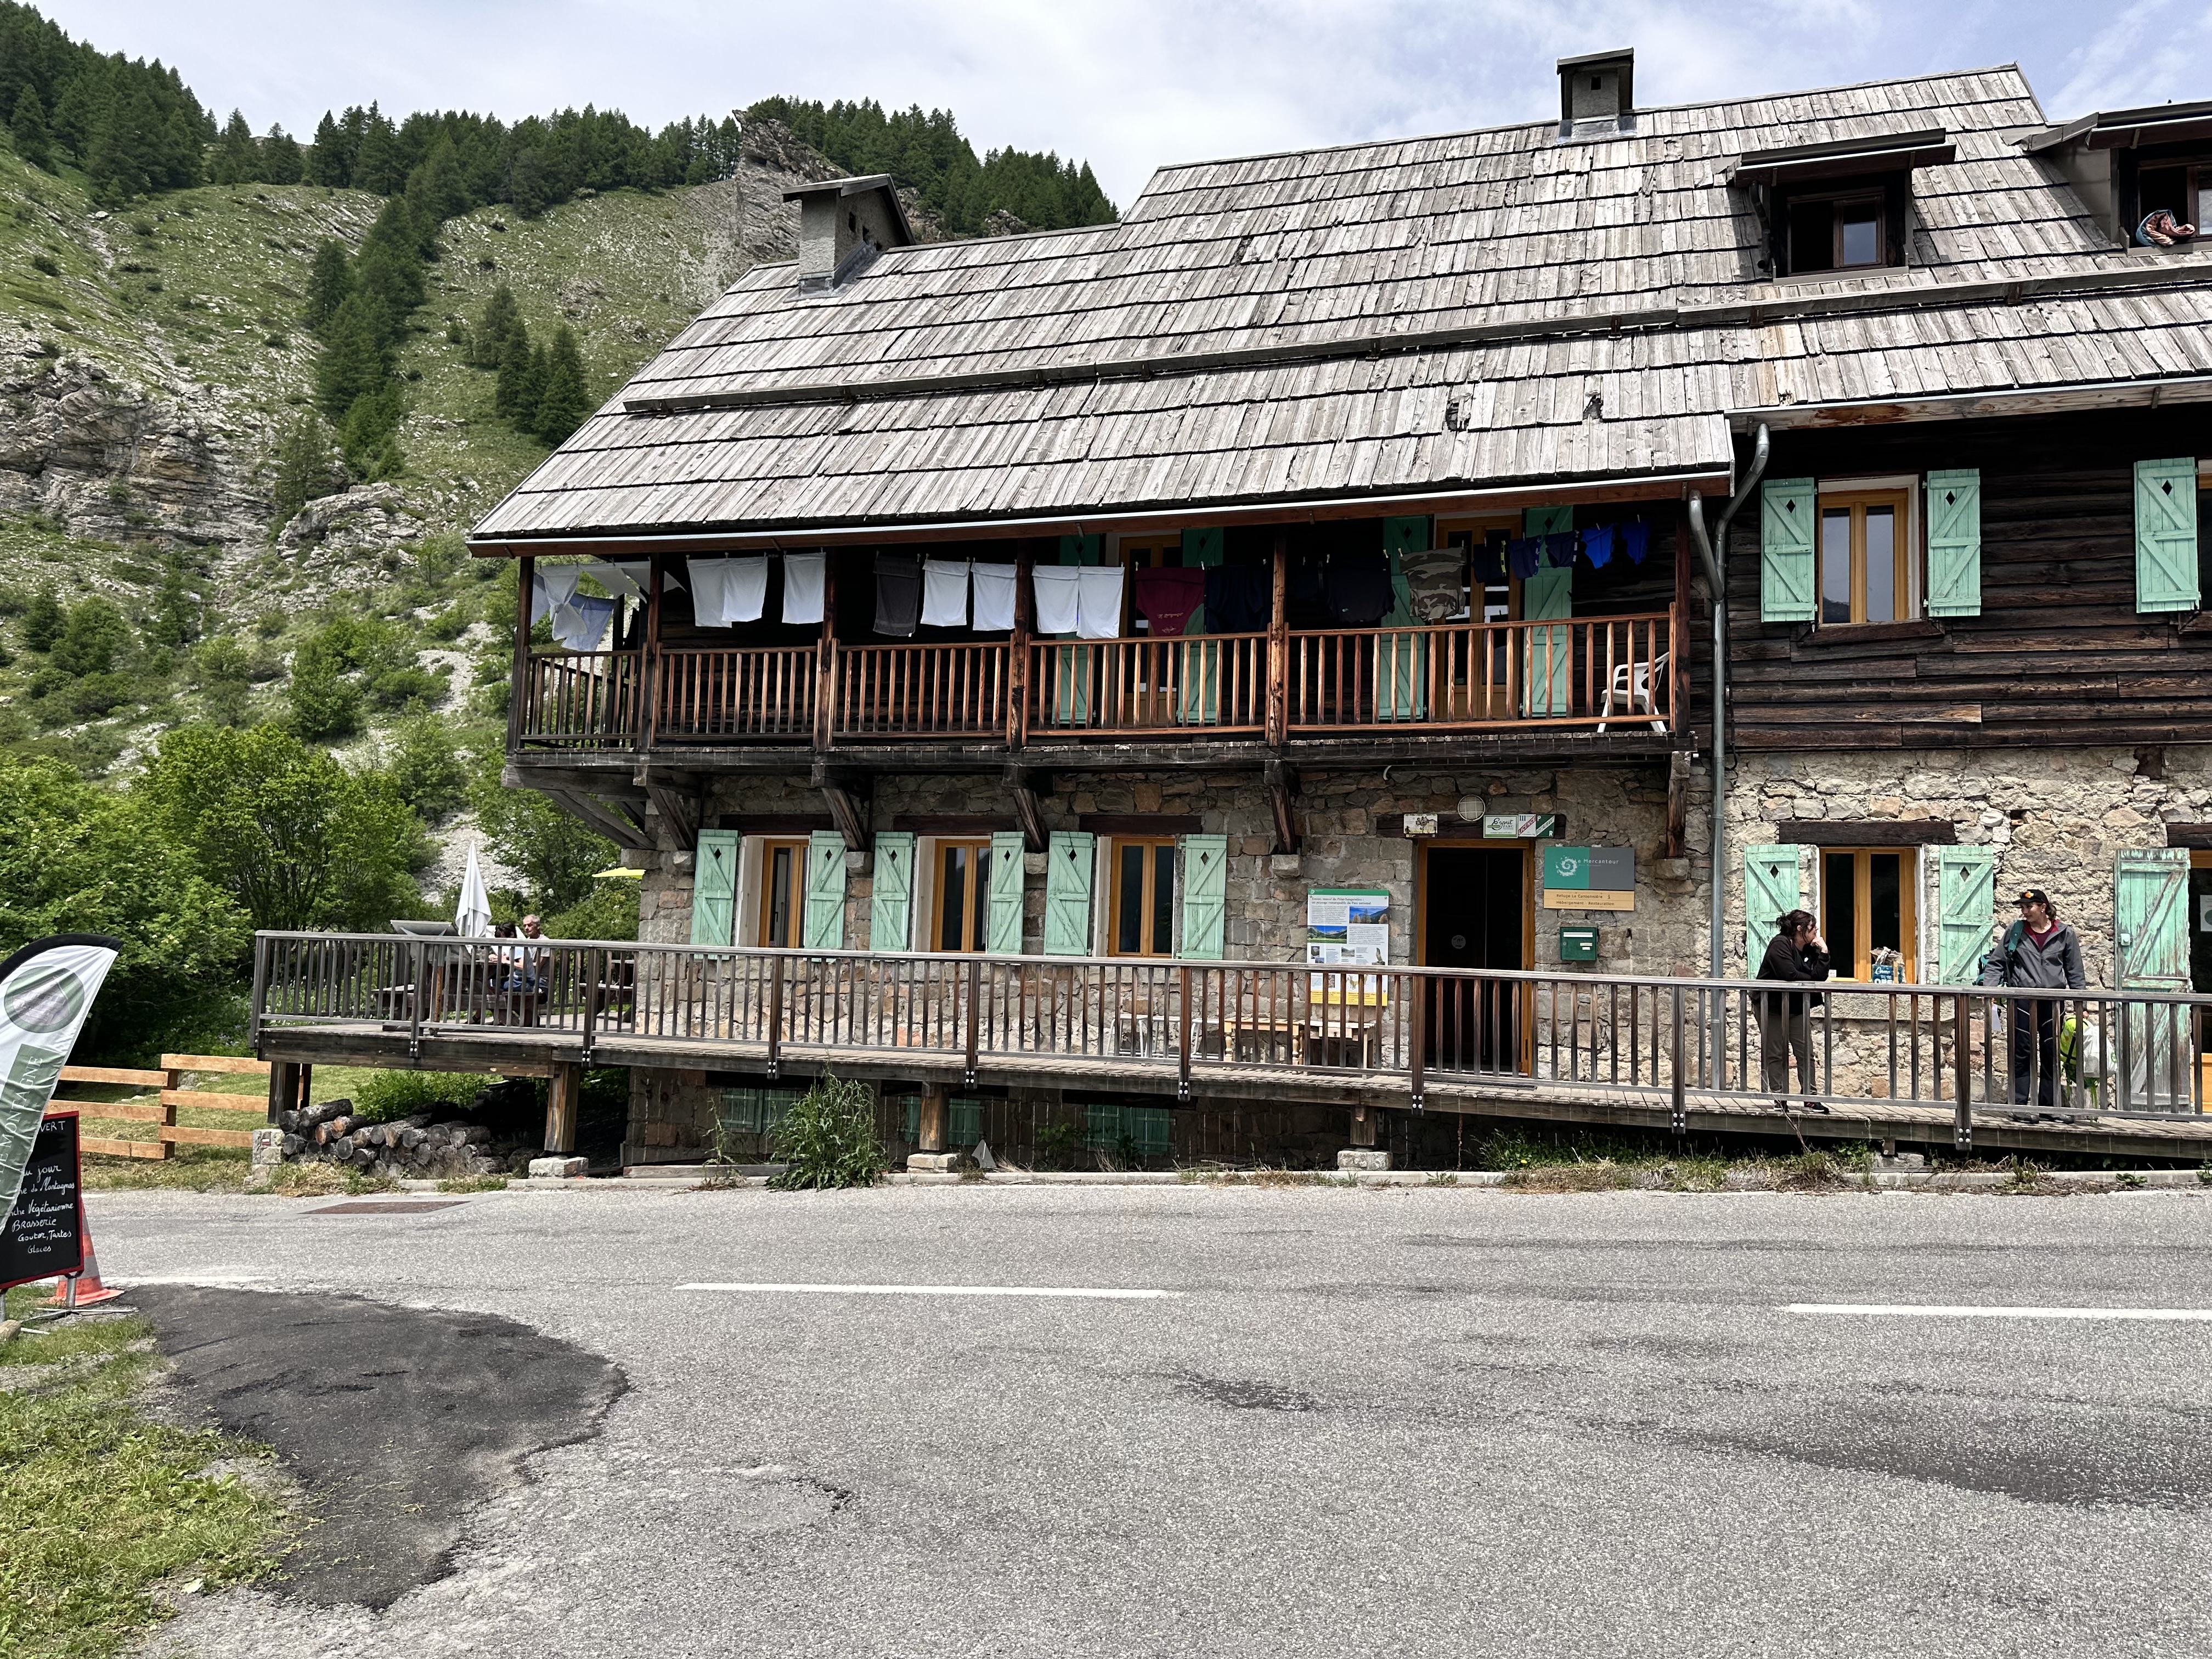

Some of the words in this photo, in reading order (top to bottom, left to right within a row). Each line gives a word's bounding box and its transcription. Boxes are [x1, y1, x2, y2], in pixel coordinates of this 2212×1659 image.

[1519, 816, 1536, 835] LICENCE
[0, 1056, 43, 1148] MONTAGNE
[40, 1121, 65, 1132] VERT
[37, 1165, 61, 1183] jour
[28, 1244, 52, 1254] Glaces
